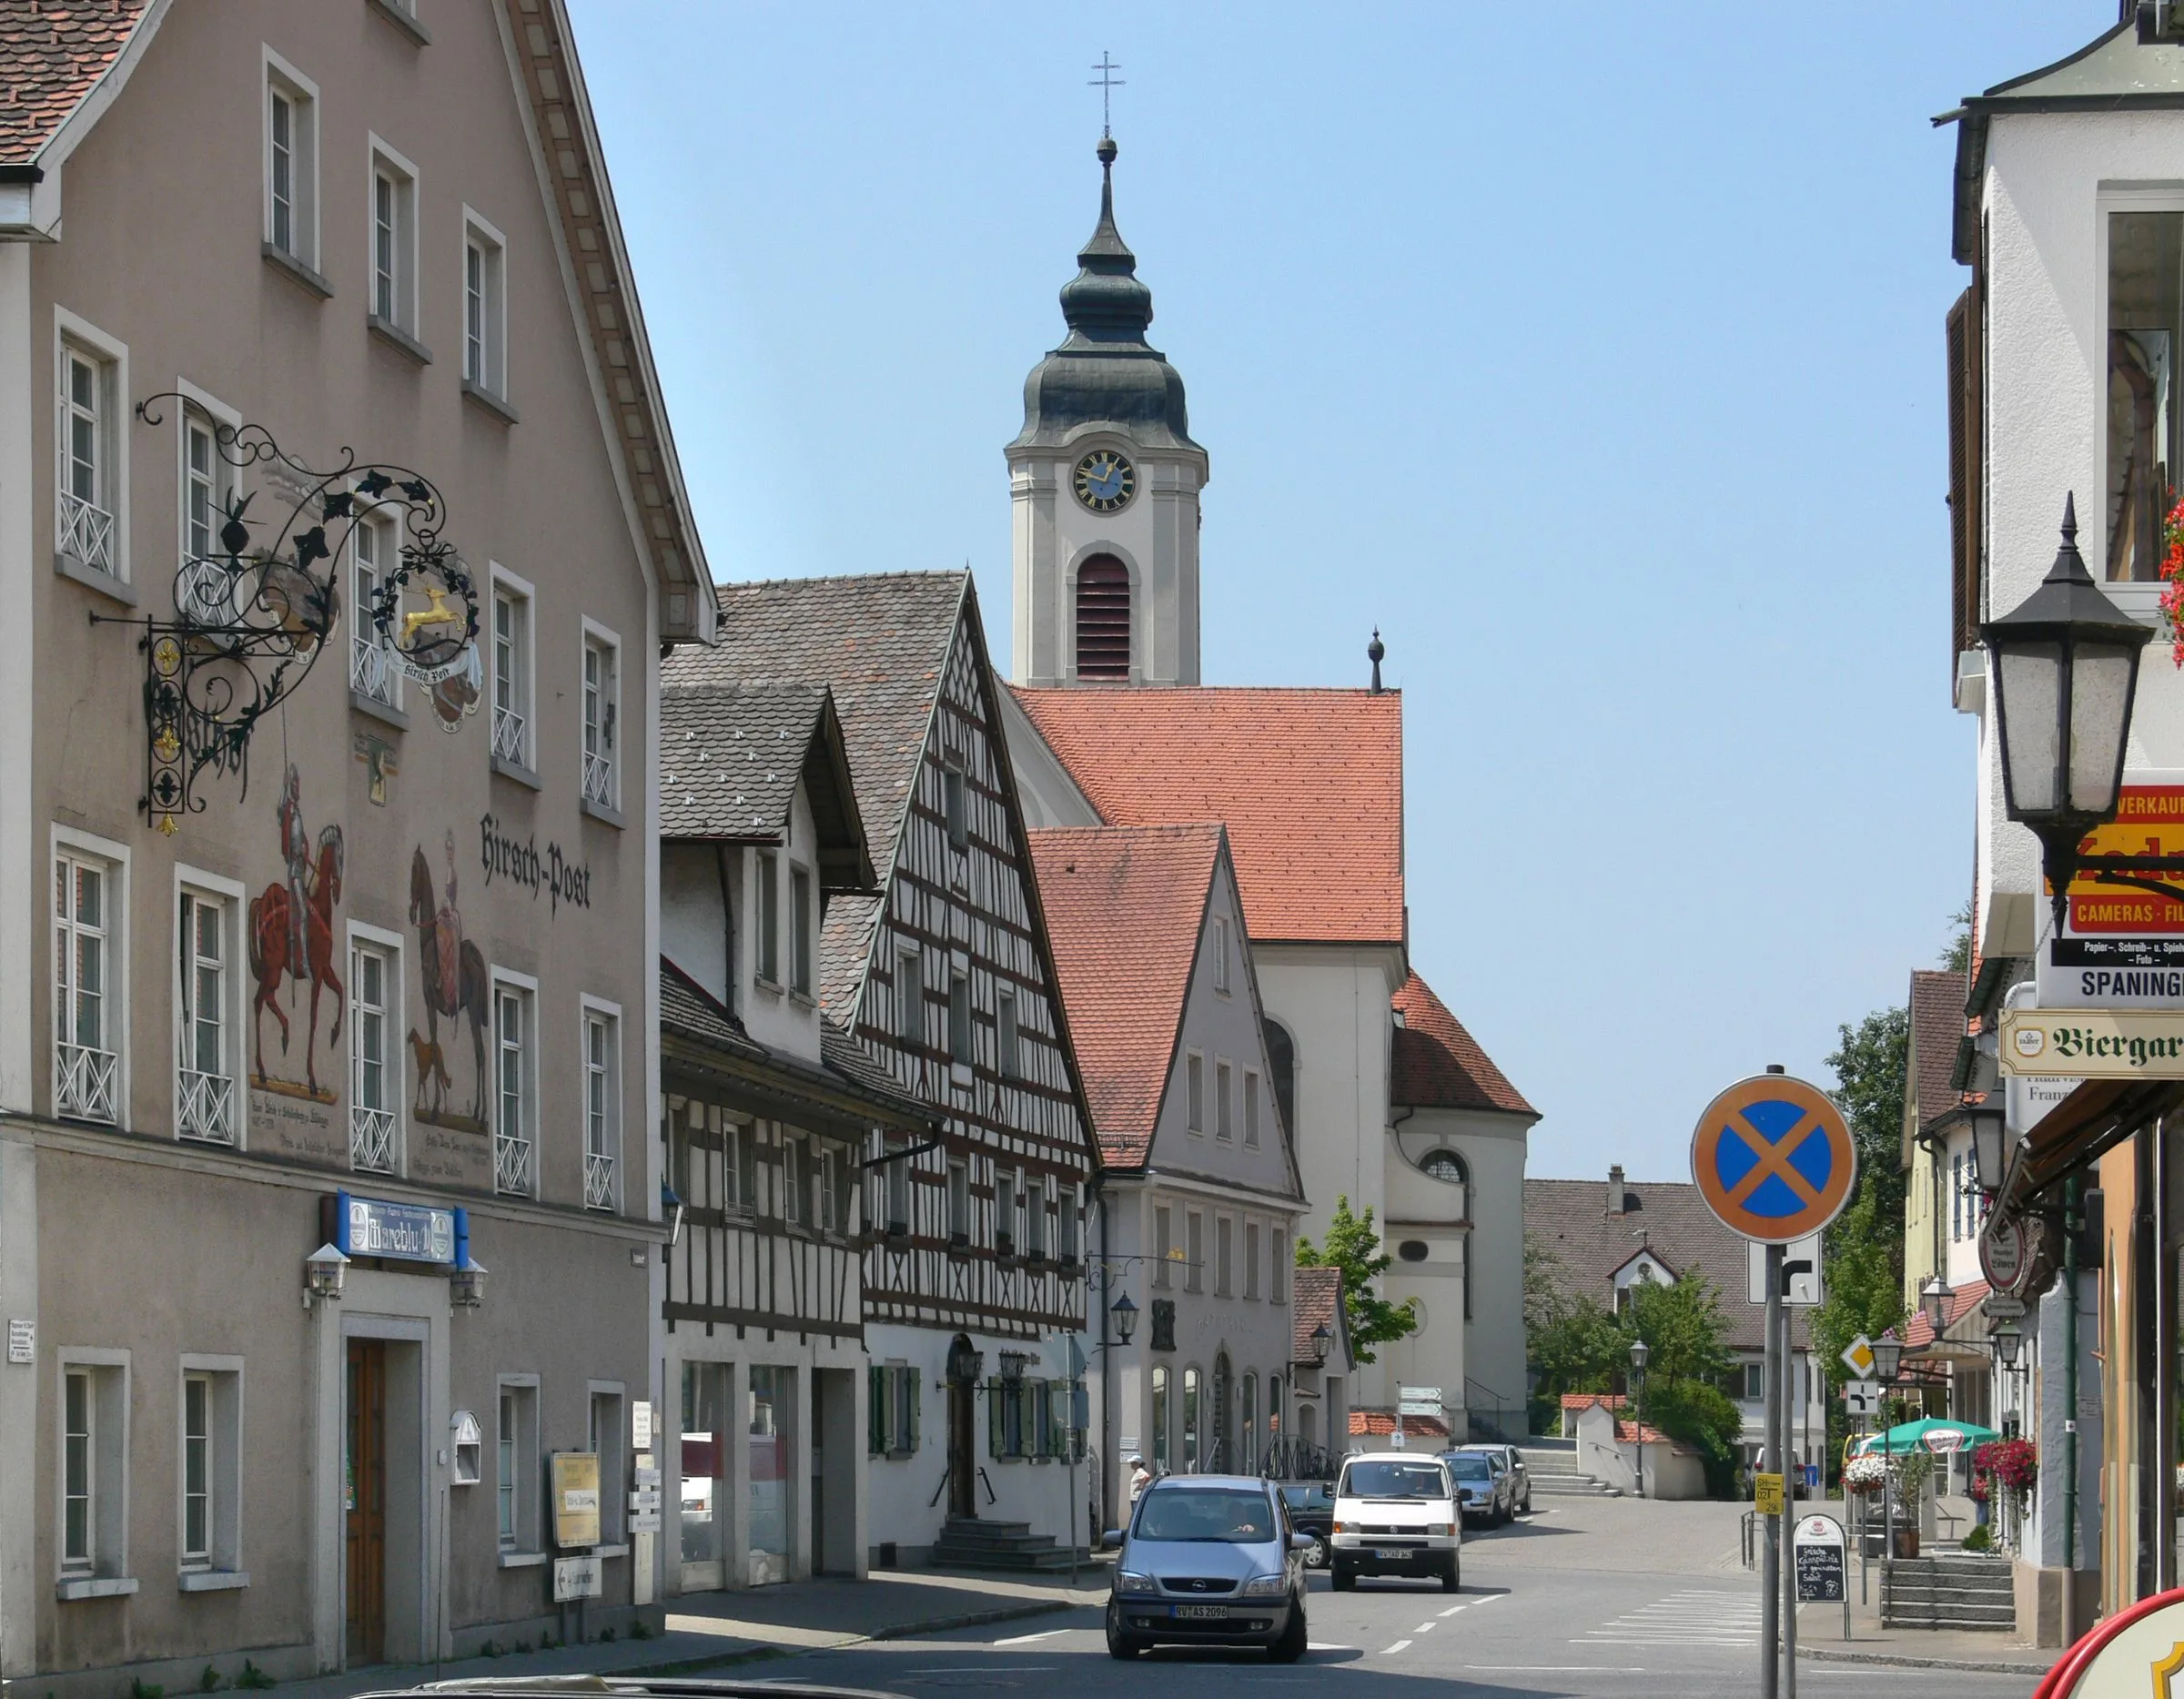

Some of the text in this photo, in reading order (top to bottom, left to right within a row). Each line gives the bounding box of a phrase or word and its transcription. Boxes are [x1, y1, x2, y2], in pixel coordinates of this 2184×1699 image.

[480, 812, 591, 922] Hirsch-Post
[2077, 904, 2154, 923] CAMERAS
[2081, 971, 2184, 996] SPANING
[1176, 1606, 1227, 1618] RV AS 2096
